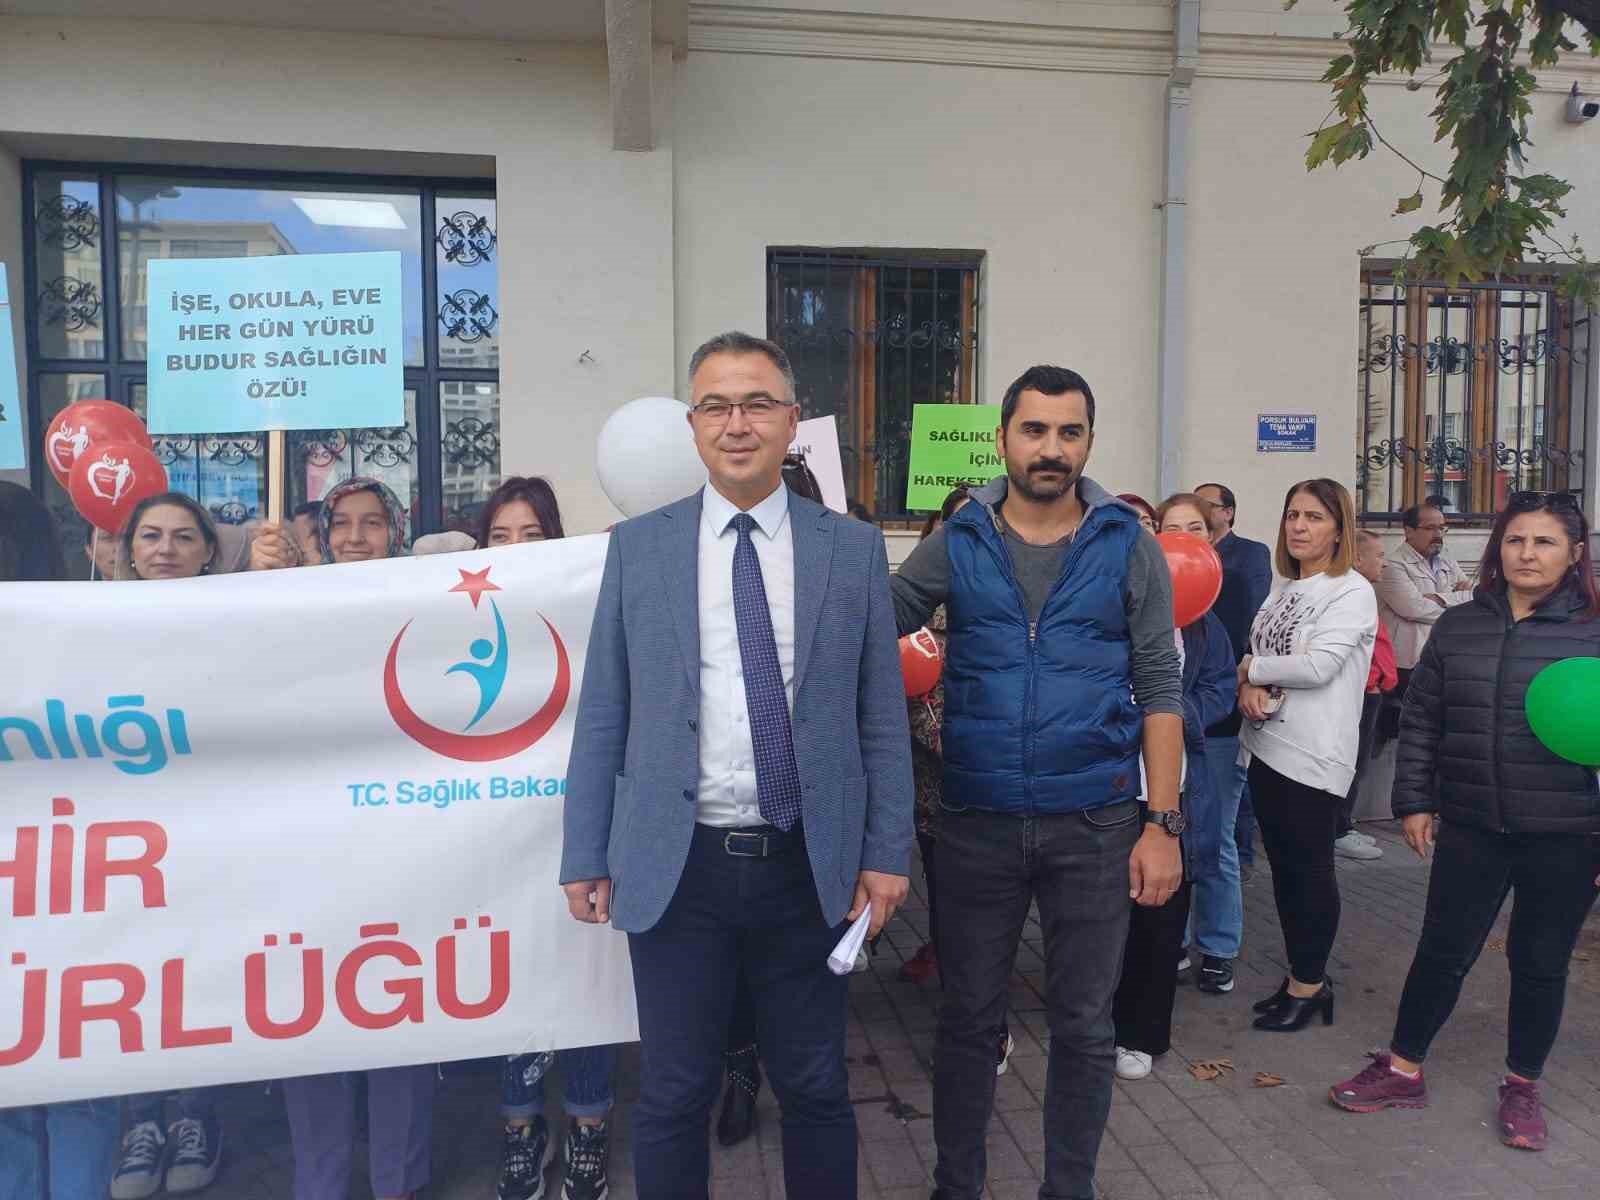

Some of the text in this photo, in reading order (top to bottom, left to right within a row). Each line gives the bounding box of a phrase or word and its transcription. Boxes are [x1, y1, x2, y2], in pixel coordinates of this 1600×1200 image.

[171, 288, 382, 315] İŞE, OKULA, EVE
[178, 314, 375, 341] HER GÜN YÜRÜ
[166, 345, 387, 371] BUDUR SAĞLIĞIN
[246, 377, 307, 399] ÖZÜ!
[929, 429, 995, 442] SAĞLIKL
[969, 451, 1002, 467] İÇİN
[0, 694, 193, 776] nlığı
[347, 782, 390, 807] T.C.
[396, 778, 481, 808] Sağlık
